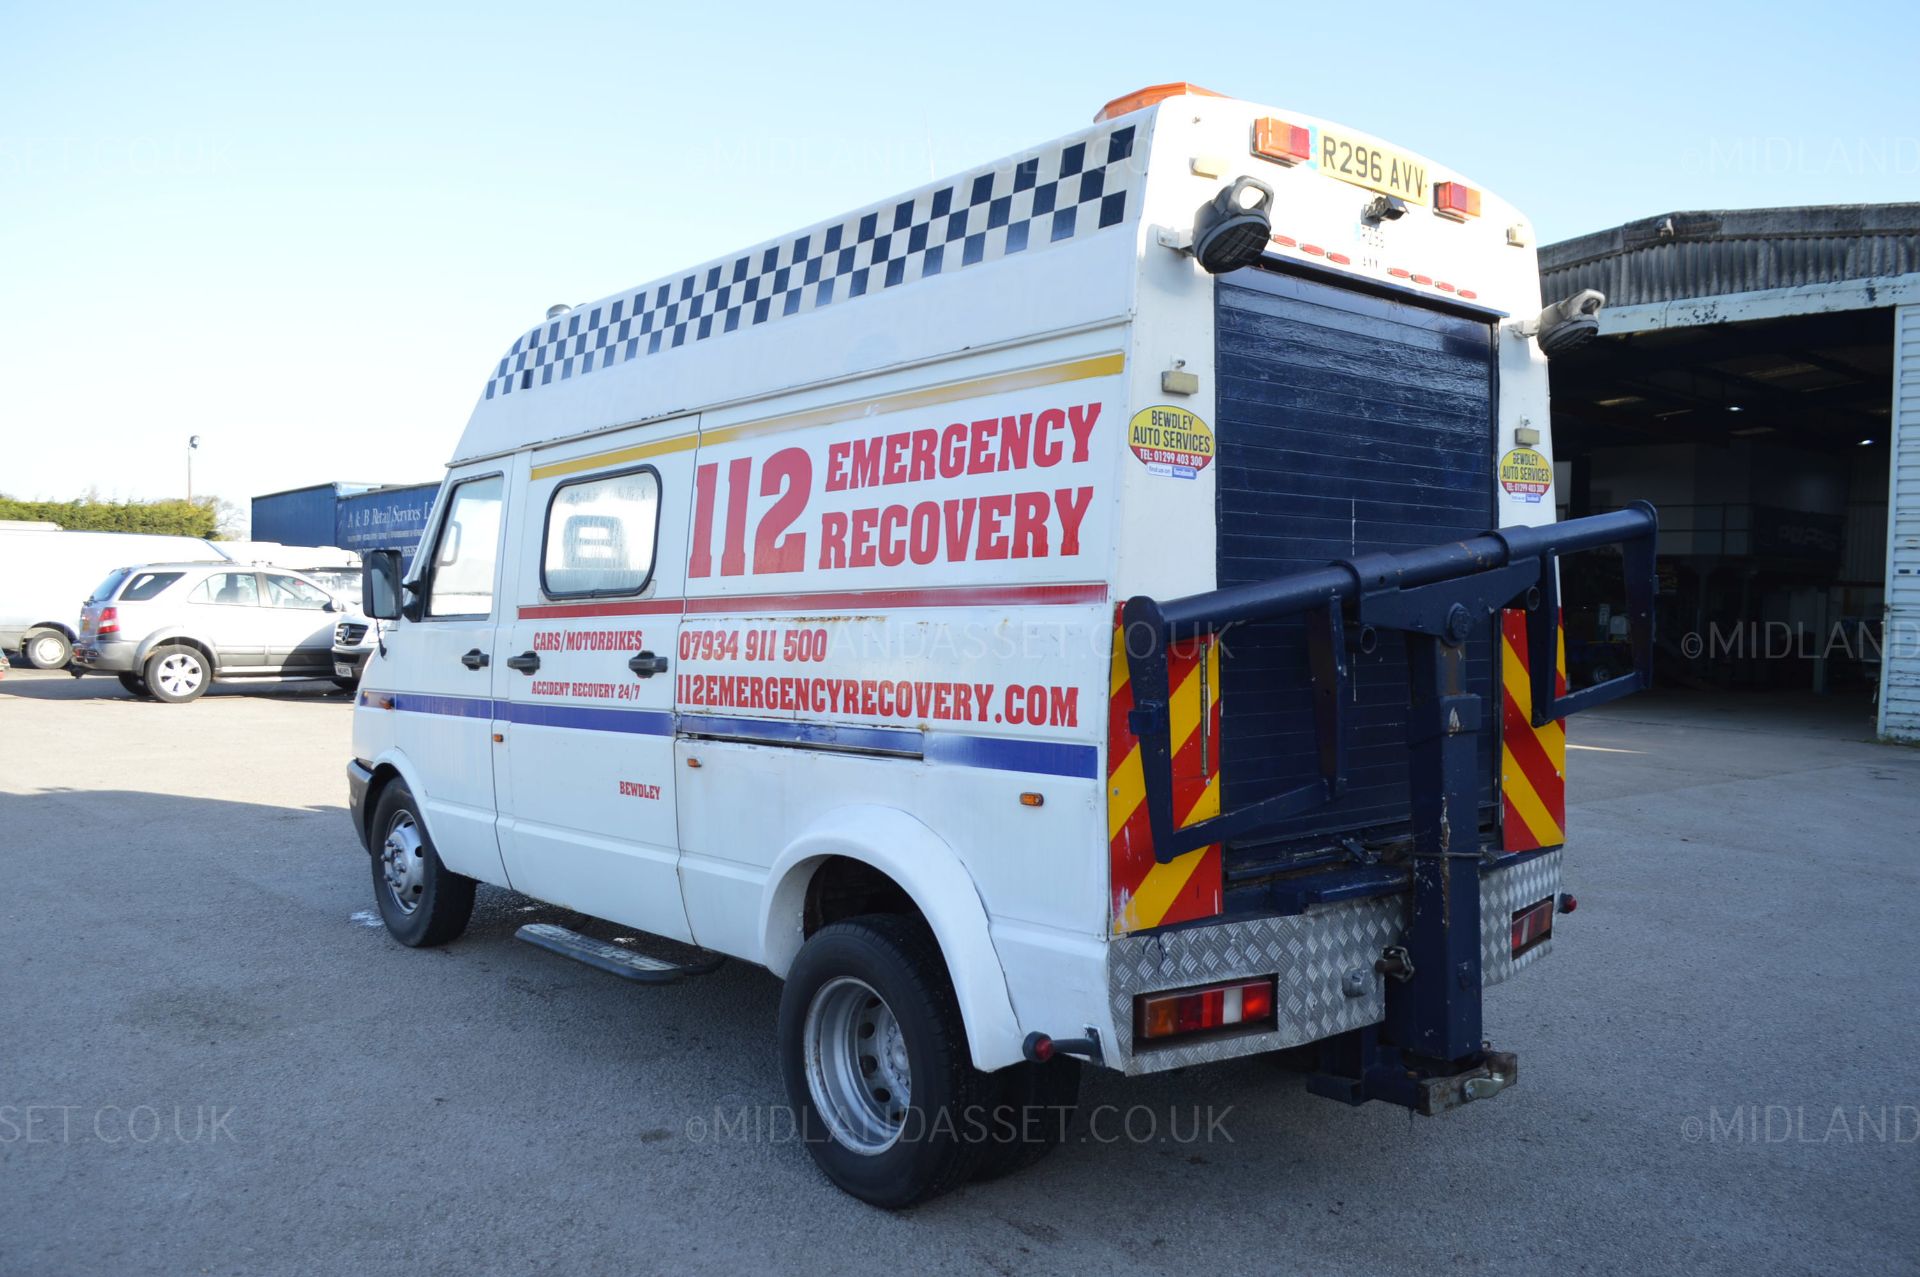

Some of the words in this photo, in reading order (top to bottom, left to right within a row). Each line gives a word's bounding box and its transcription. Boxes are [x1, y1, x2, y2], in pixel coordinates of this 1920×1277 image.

[1323, 135, 1382, 182] R296
[1390, 158, 1424, 198] AVV
[1151, 410, 1194, 431] BEWDLEY
[1133, 426, 1160, 446] AUTO
[1163, 430, 1210, 453] SERVICES
[1140, 448, 1153, 460] TEL:
[1154, 450, 1175, 463] 01299
[1513, 452, 1538, 465] BEWDLEY
[1503, 465, 1519, 480] AUTO
[1520, 467, 1549, 481] SERVICES
[688, 447, 812, 578] 112
[825, 402, 1102, 492] EMERGENCY
[363, 509, 370, 526] B
[372, 506, 391, 525] Retail
[392, 504, 421, 522] Services
[819, 486, 1093, 569] RECOVERY
[533, 630, 642, 652] CARS/MOTORBIKES
[679, 630, 740, 661] 07934
[745, 629, 777, 661] 911
[783, 628, 828, 662] 500
[532, 681, 570, 696] ACCIDENT
[572, 683, 616, 699] RECOVERY
[618, 683, 641, 701] 24/7
[677, 674, 1079, 728] 112EMERGENCYRECOVERY.COM
[619, 780, 661, 800] BEWDLEY
